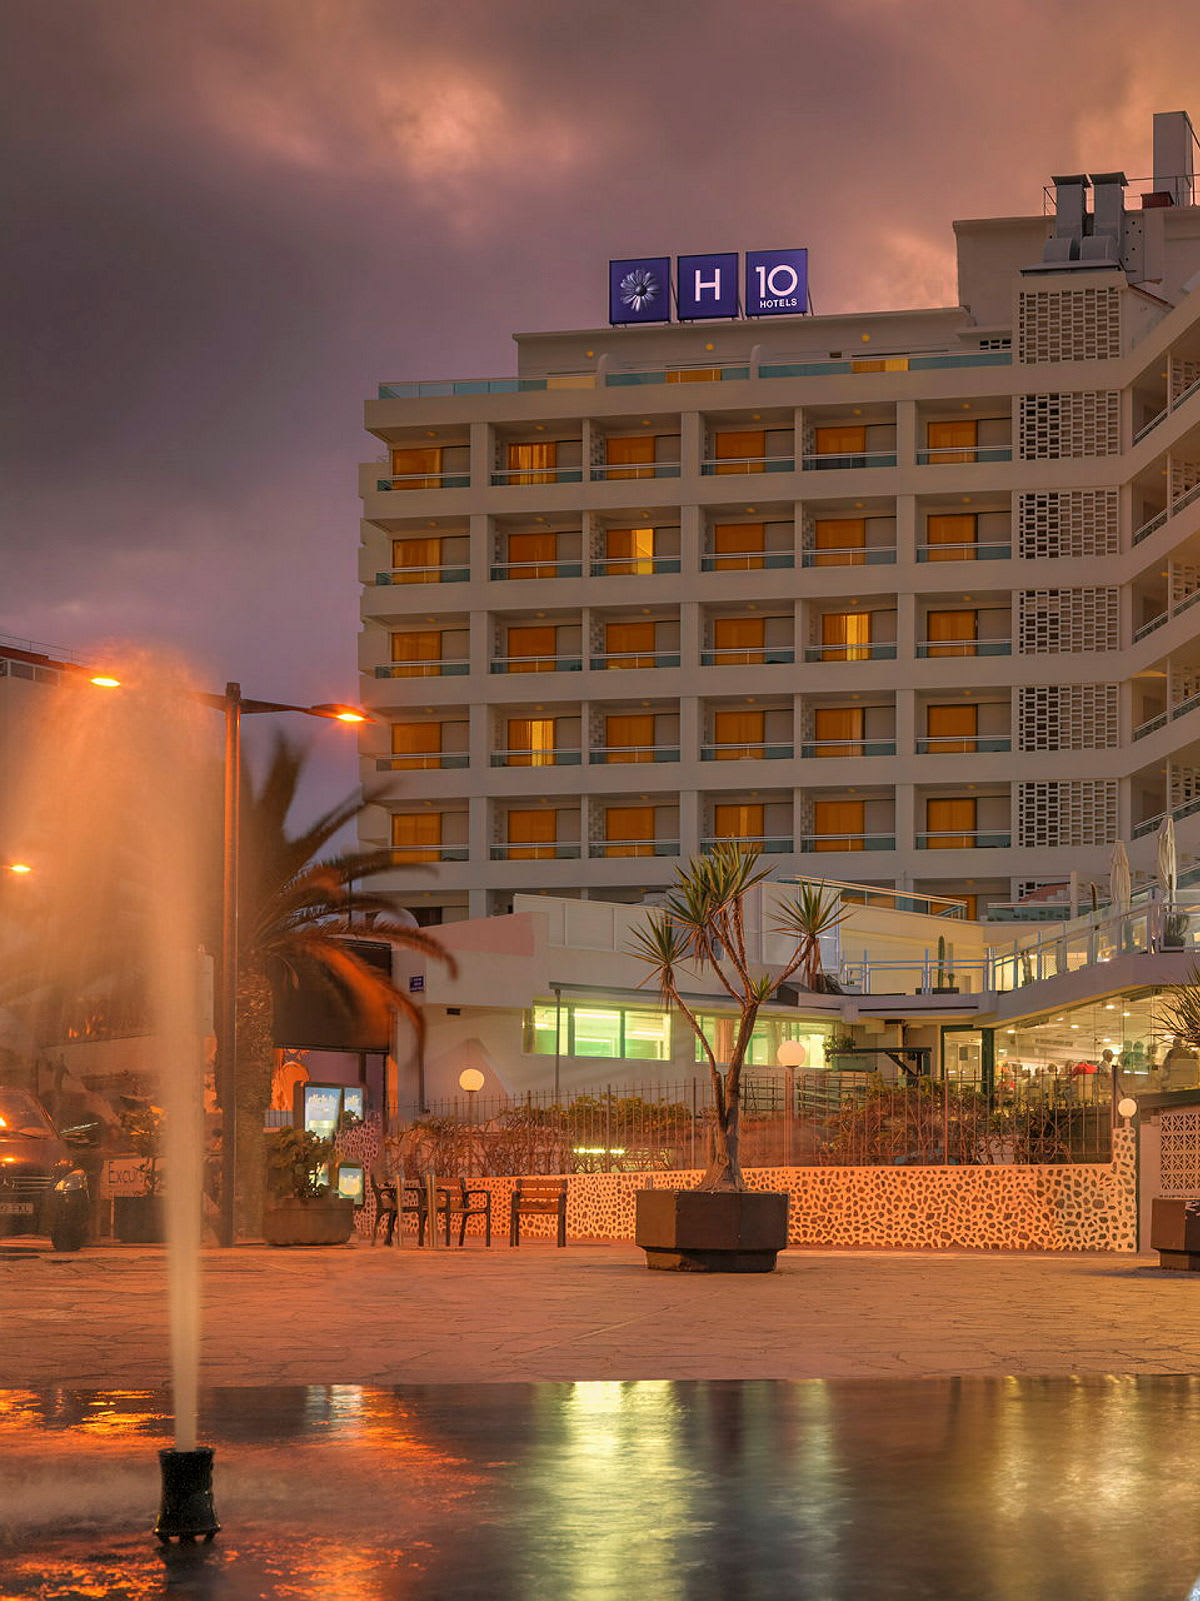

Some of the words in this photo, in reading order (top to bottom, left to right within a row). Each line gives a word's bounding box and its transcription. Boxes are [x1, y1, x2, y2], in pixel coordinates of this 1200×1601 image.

[695, 268, 721, 302] H
[755, 264, 798, 298] 10
[759, 298, 798, 309] HOTELS
